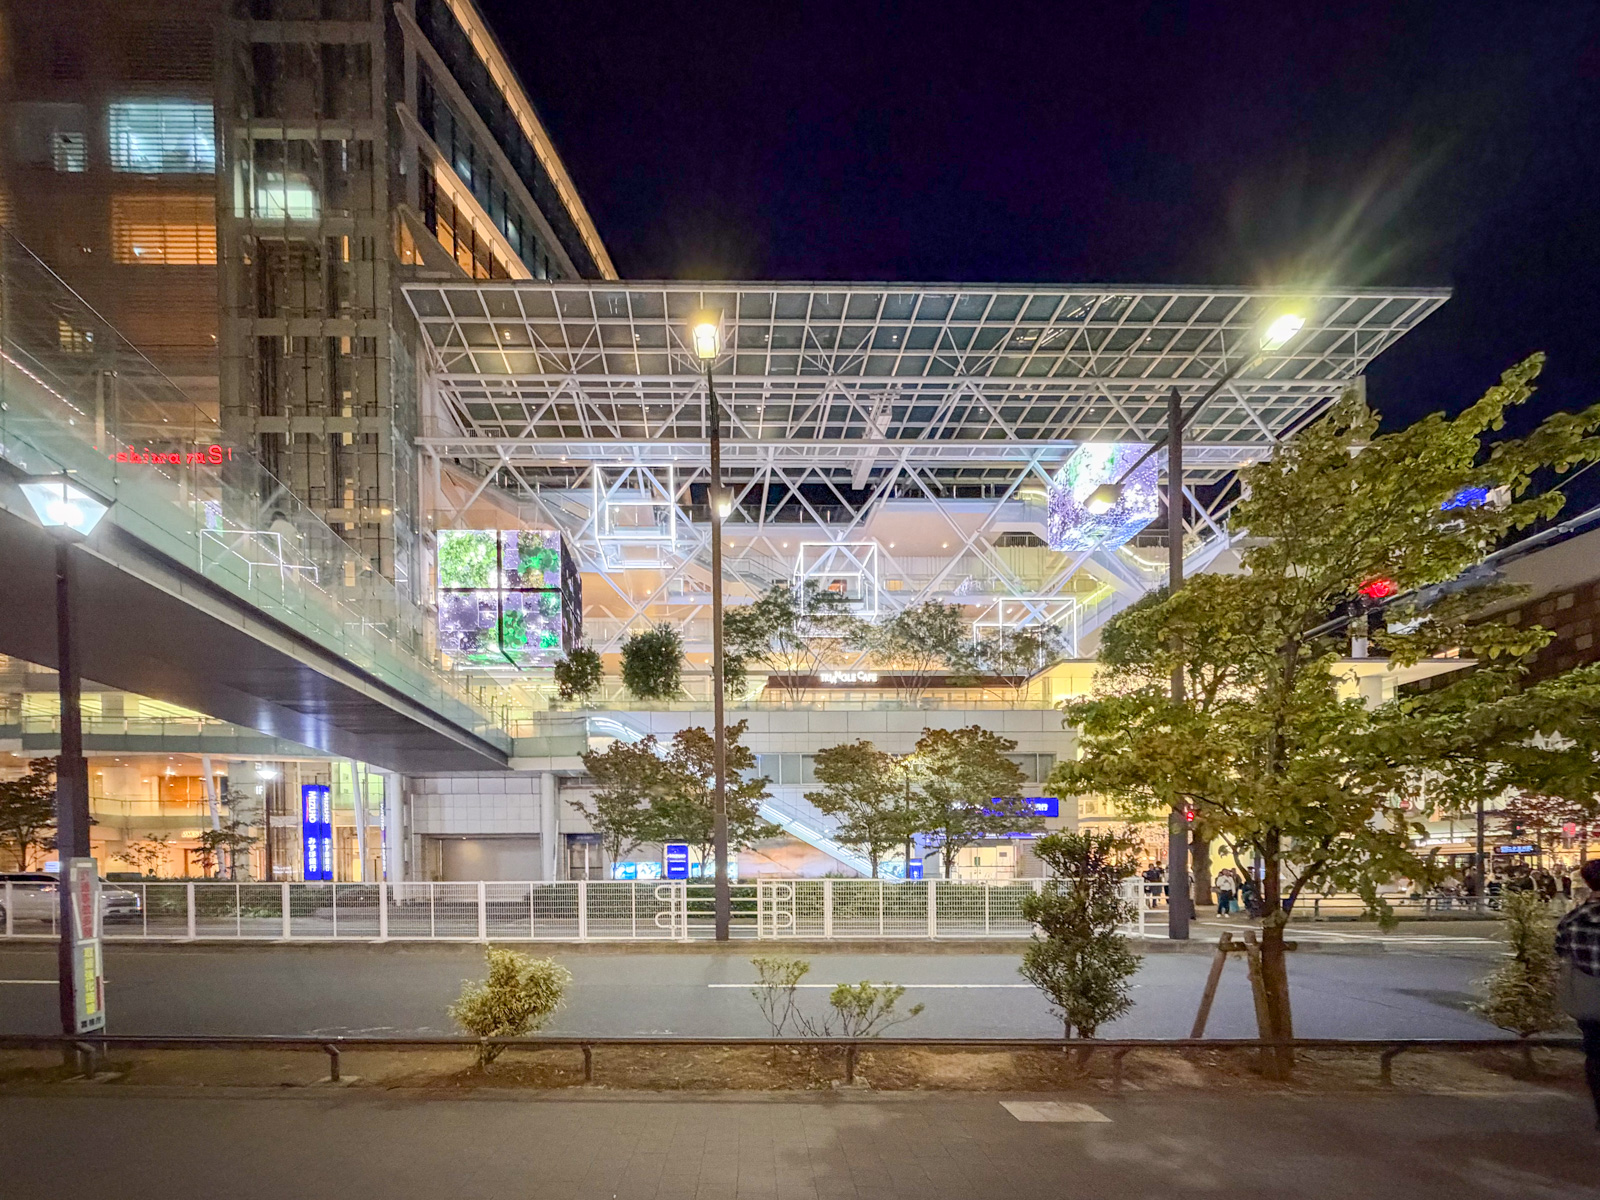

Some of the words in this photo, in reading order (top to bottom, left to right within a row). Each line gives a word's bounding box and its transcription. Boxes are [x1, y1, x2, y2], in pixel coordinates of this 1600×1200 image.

[820, 671, 857, 684] TRIANGLE
[857, 671, 878, 682] CAFE
[308, 790, 317, 824] MIZUHO
